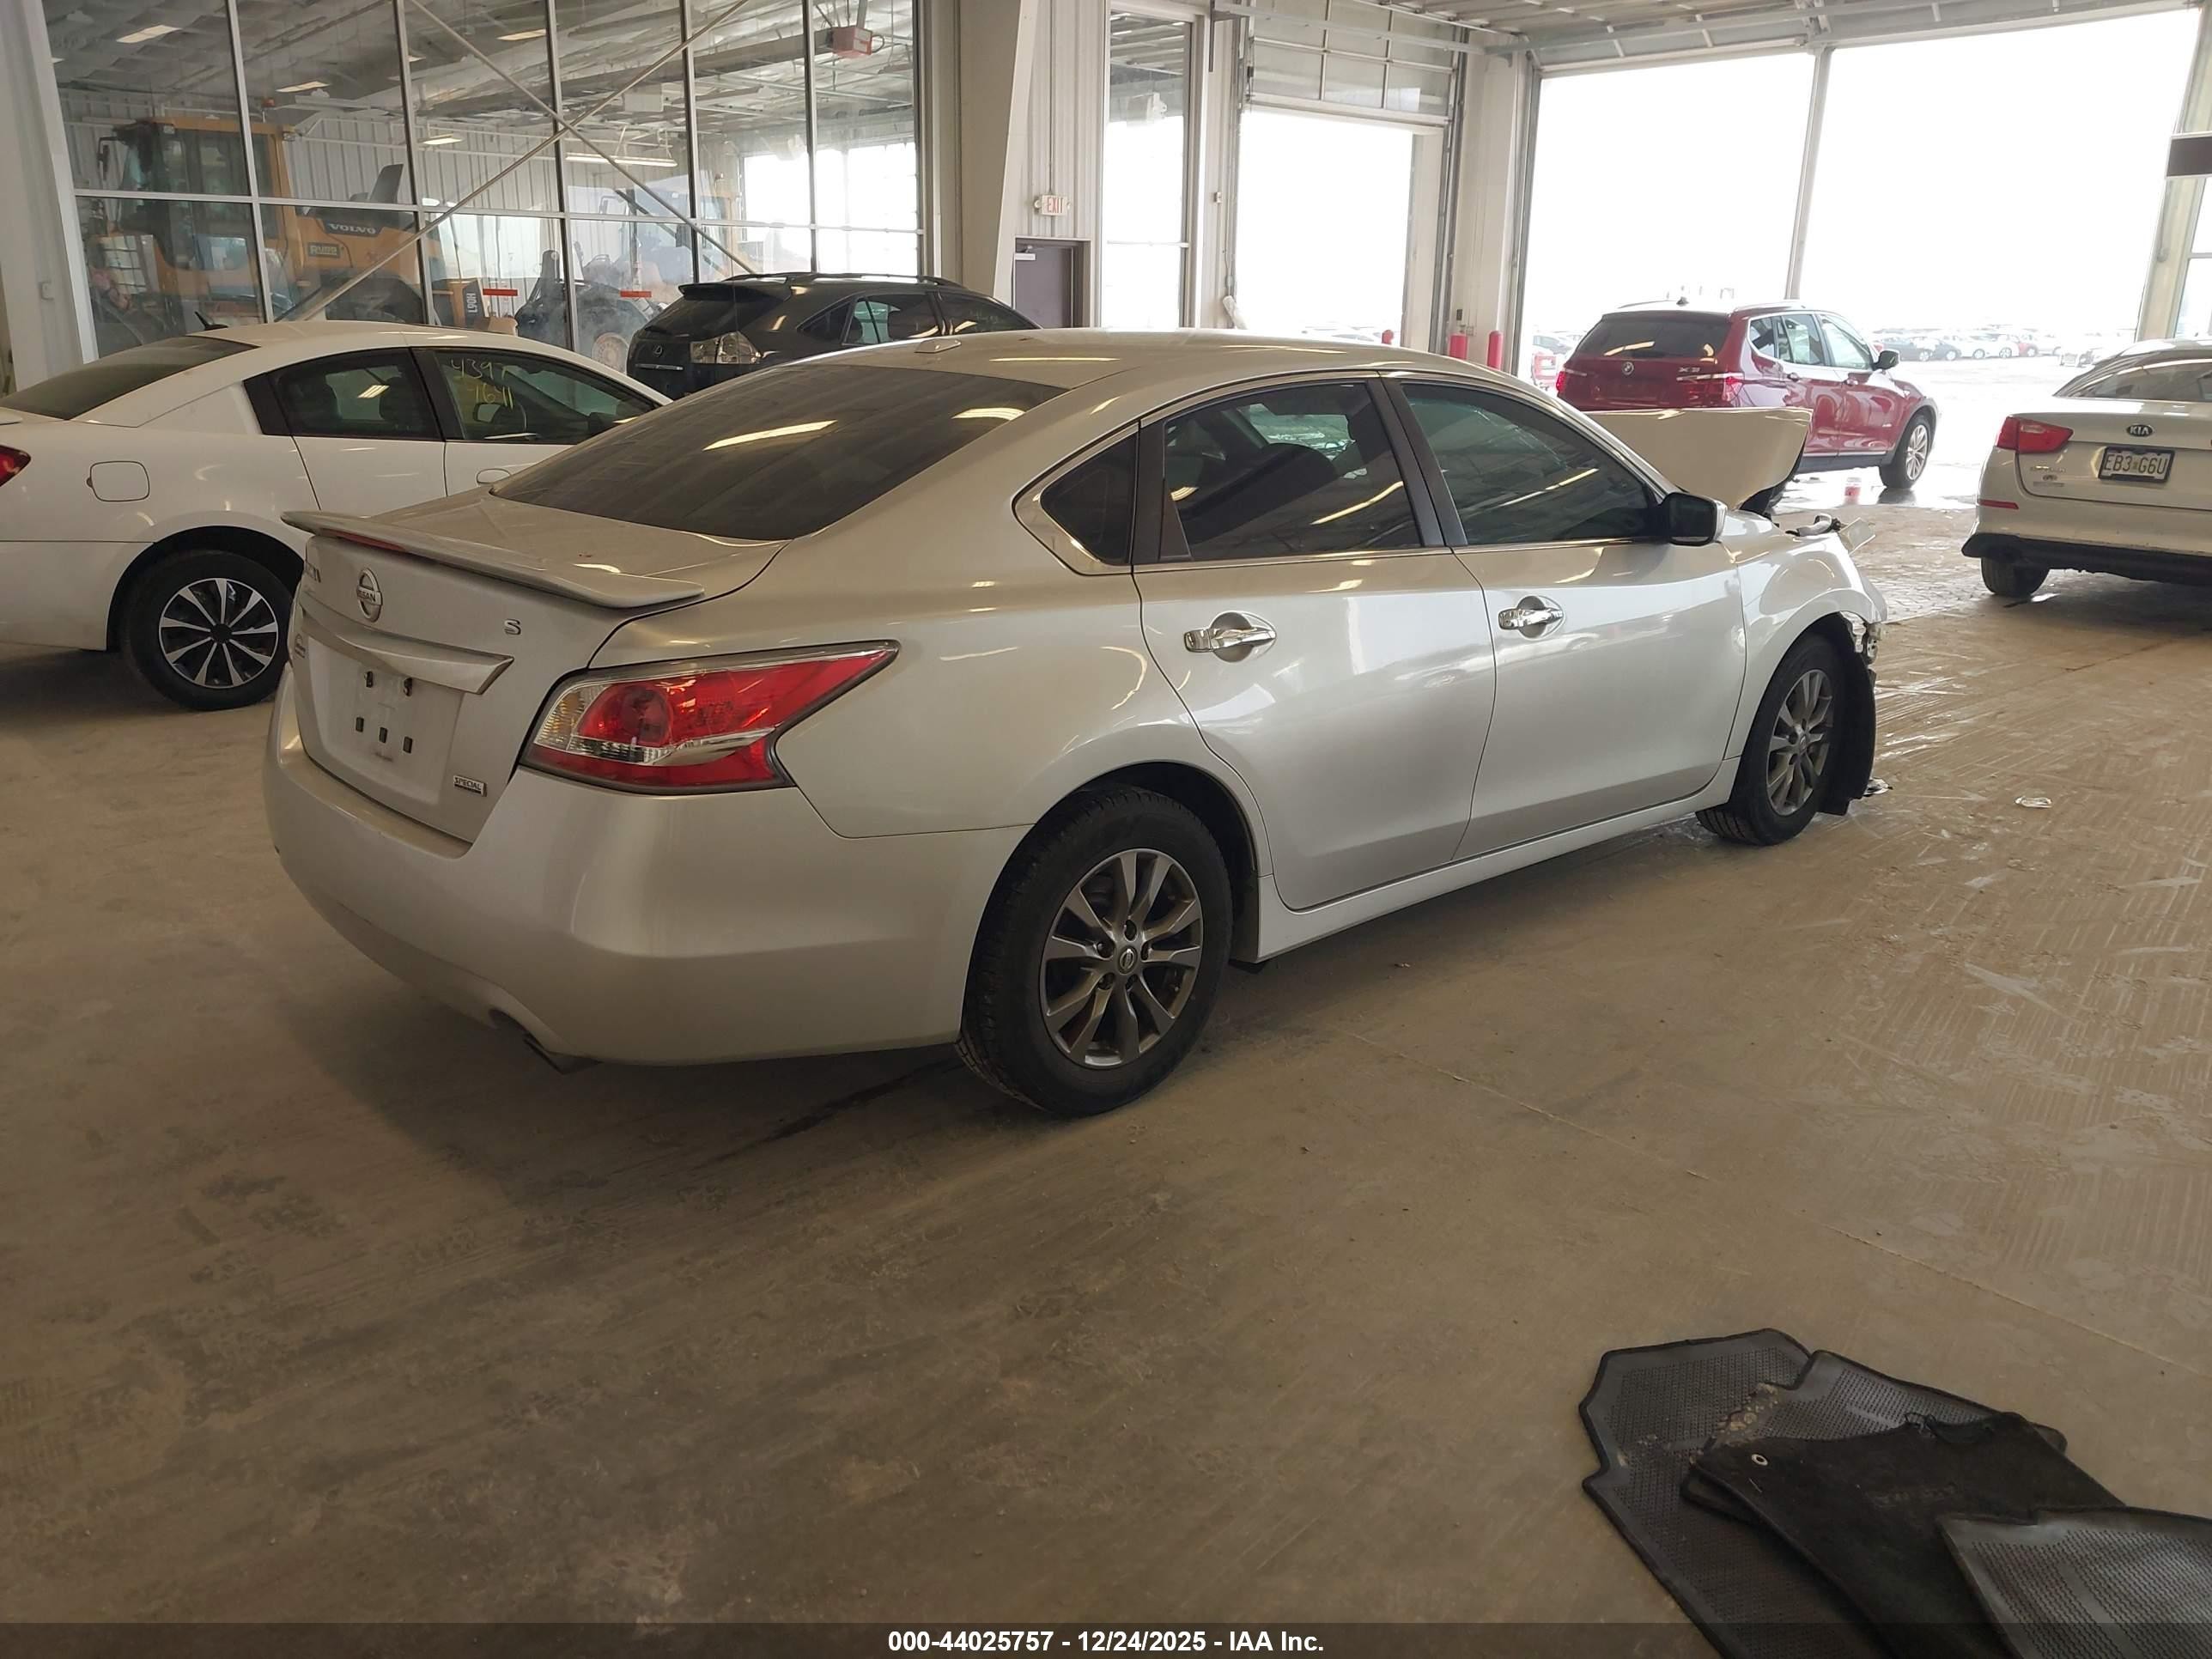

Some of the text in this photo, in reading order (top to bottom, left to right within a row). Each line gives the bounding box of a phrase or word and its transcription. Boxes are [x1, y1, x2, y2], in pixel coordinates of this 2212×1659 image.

[1047, 197, 1064, 214] EXIT
[327, 222, 377, 234] VOLVO
[465, 292, 478, 313] L90H
[2130, 425, 2149, 435] KIA
[2103, 453, 2168, 475] EB3 G6U
[504, 618, 521, 635] S
[454, 775, 482, 791] SPECIAL
